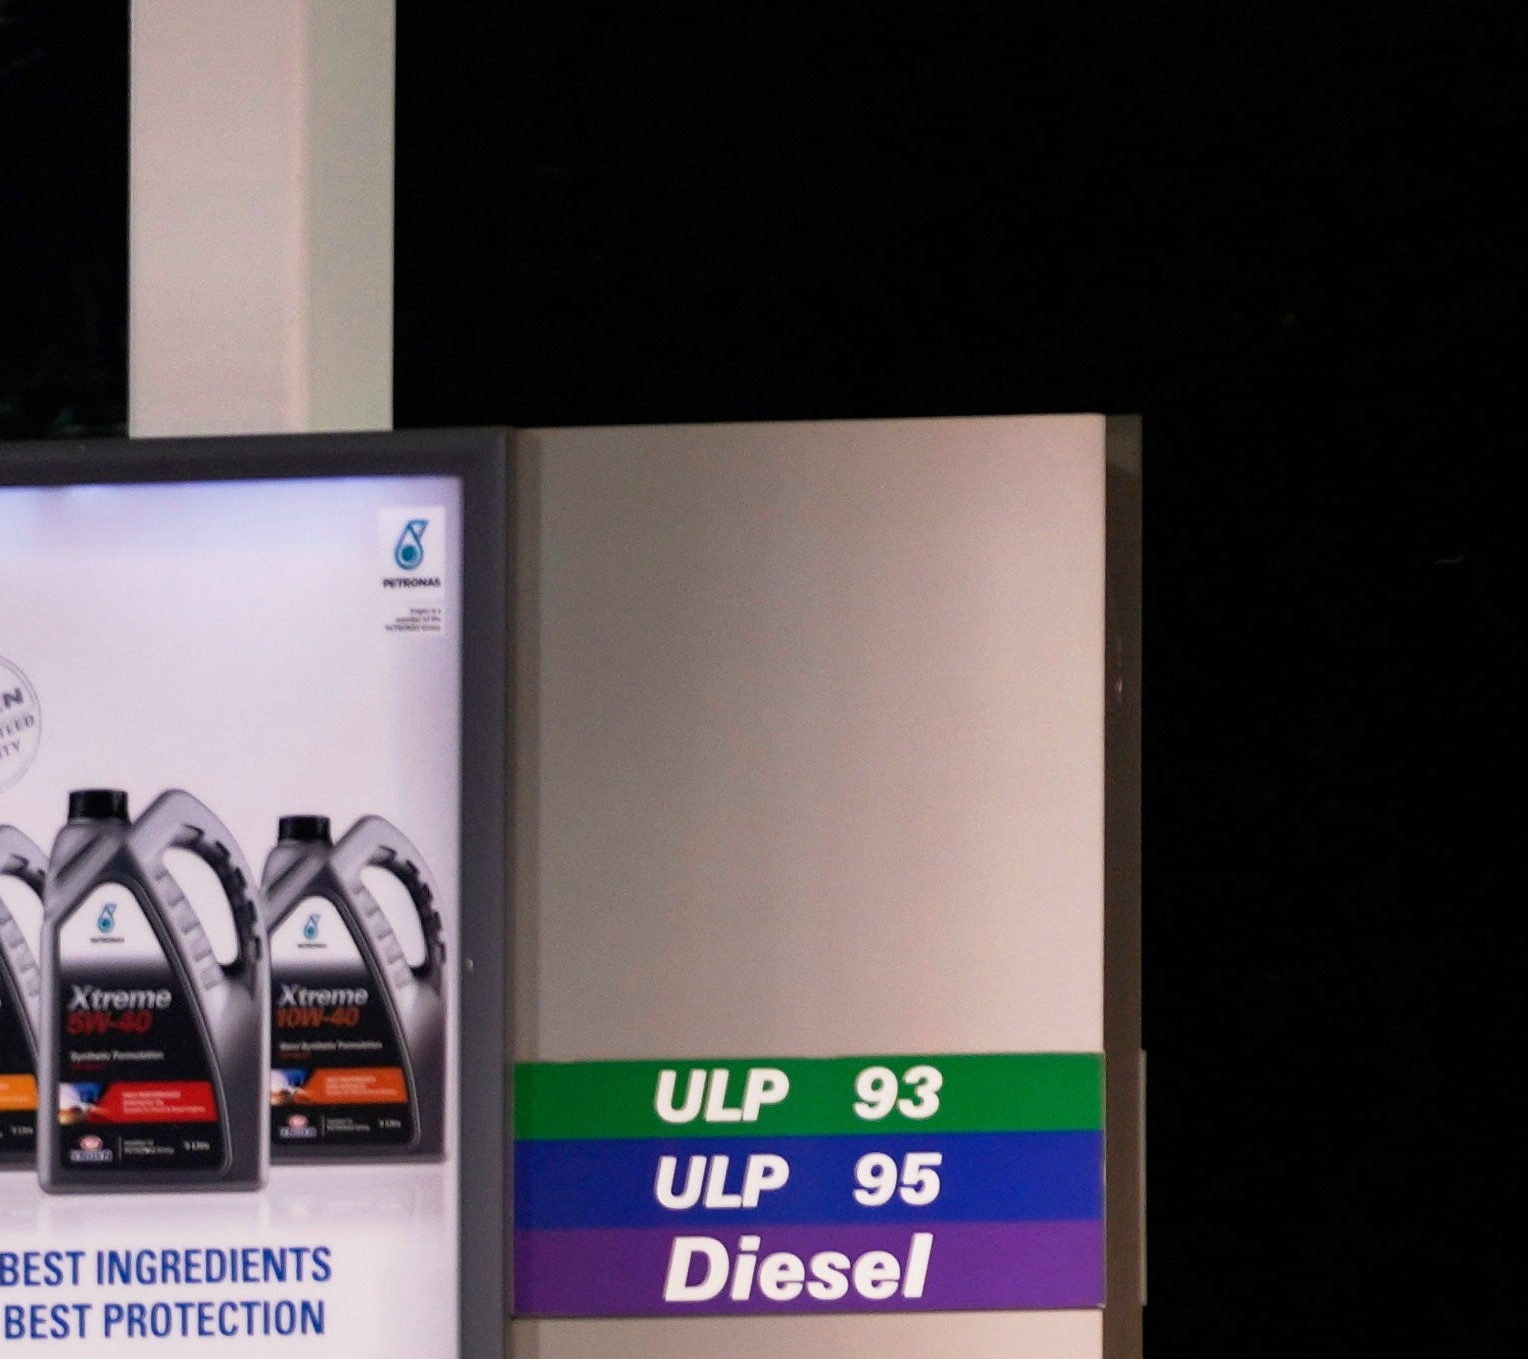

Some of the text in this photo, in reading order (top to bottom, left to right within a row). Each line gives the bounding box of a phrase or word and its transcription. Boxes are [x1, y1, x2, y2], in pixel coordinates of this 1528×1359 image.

[66, 984, 173, 1010] Xtreme
[277, 984, 369, 1007] Xtreme
[653, 1065, 944, 1123] ULP 93
[653, 1152, 944, 1209] ULP 95
[97, 1245, 332, 1285] INGREDIENTS
[663, 1233, 934, 1302] Diesel
[4, 1298, 326, 1340] BEST PROTECTION
